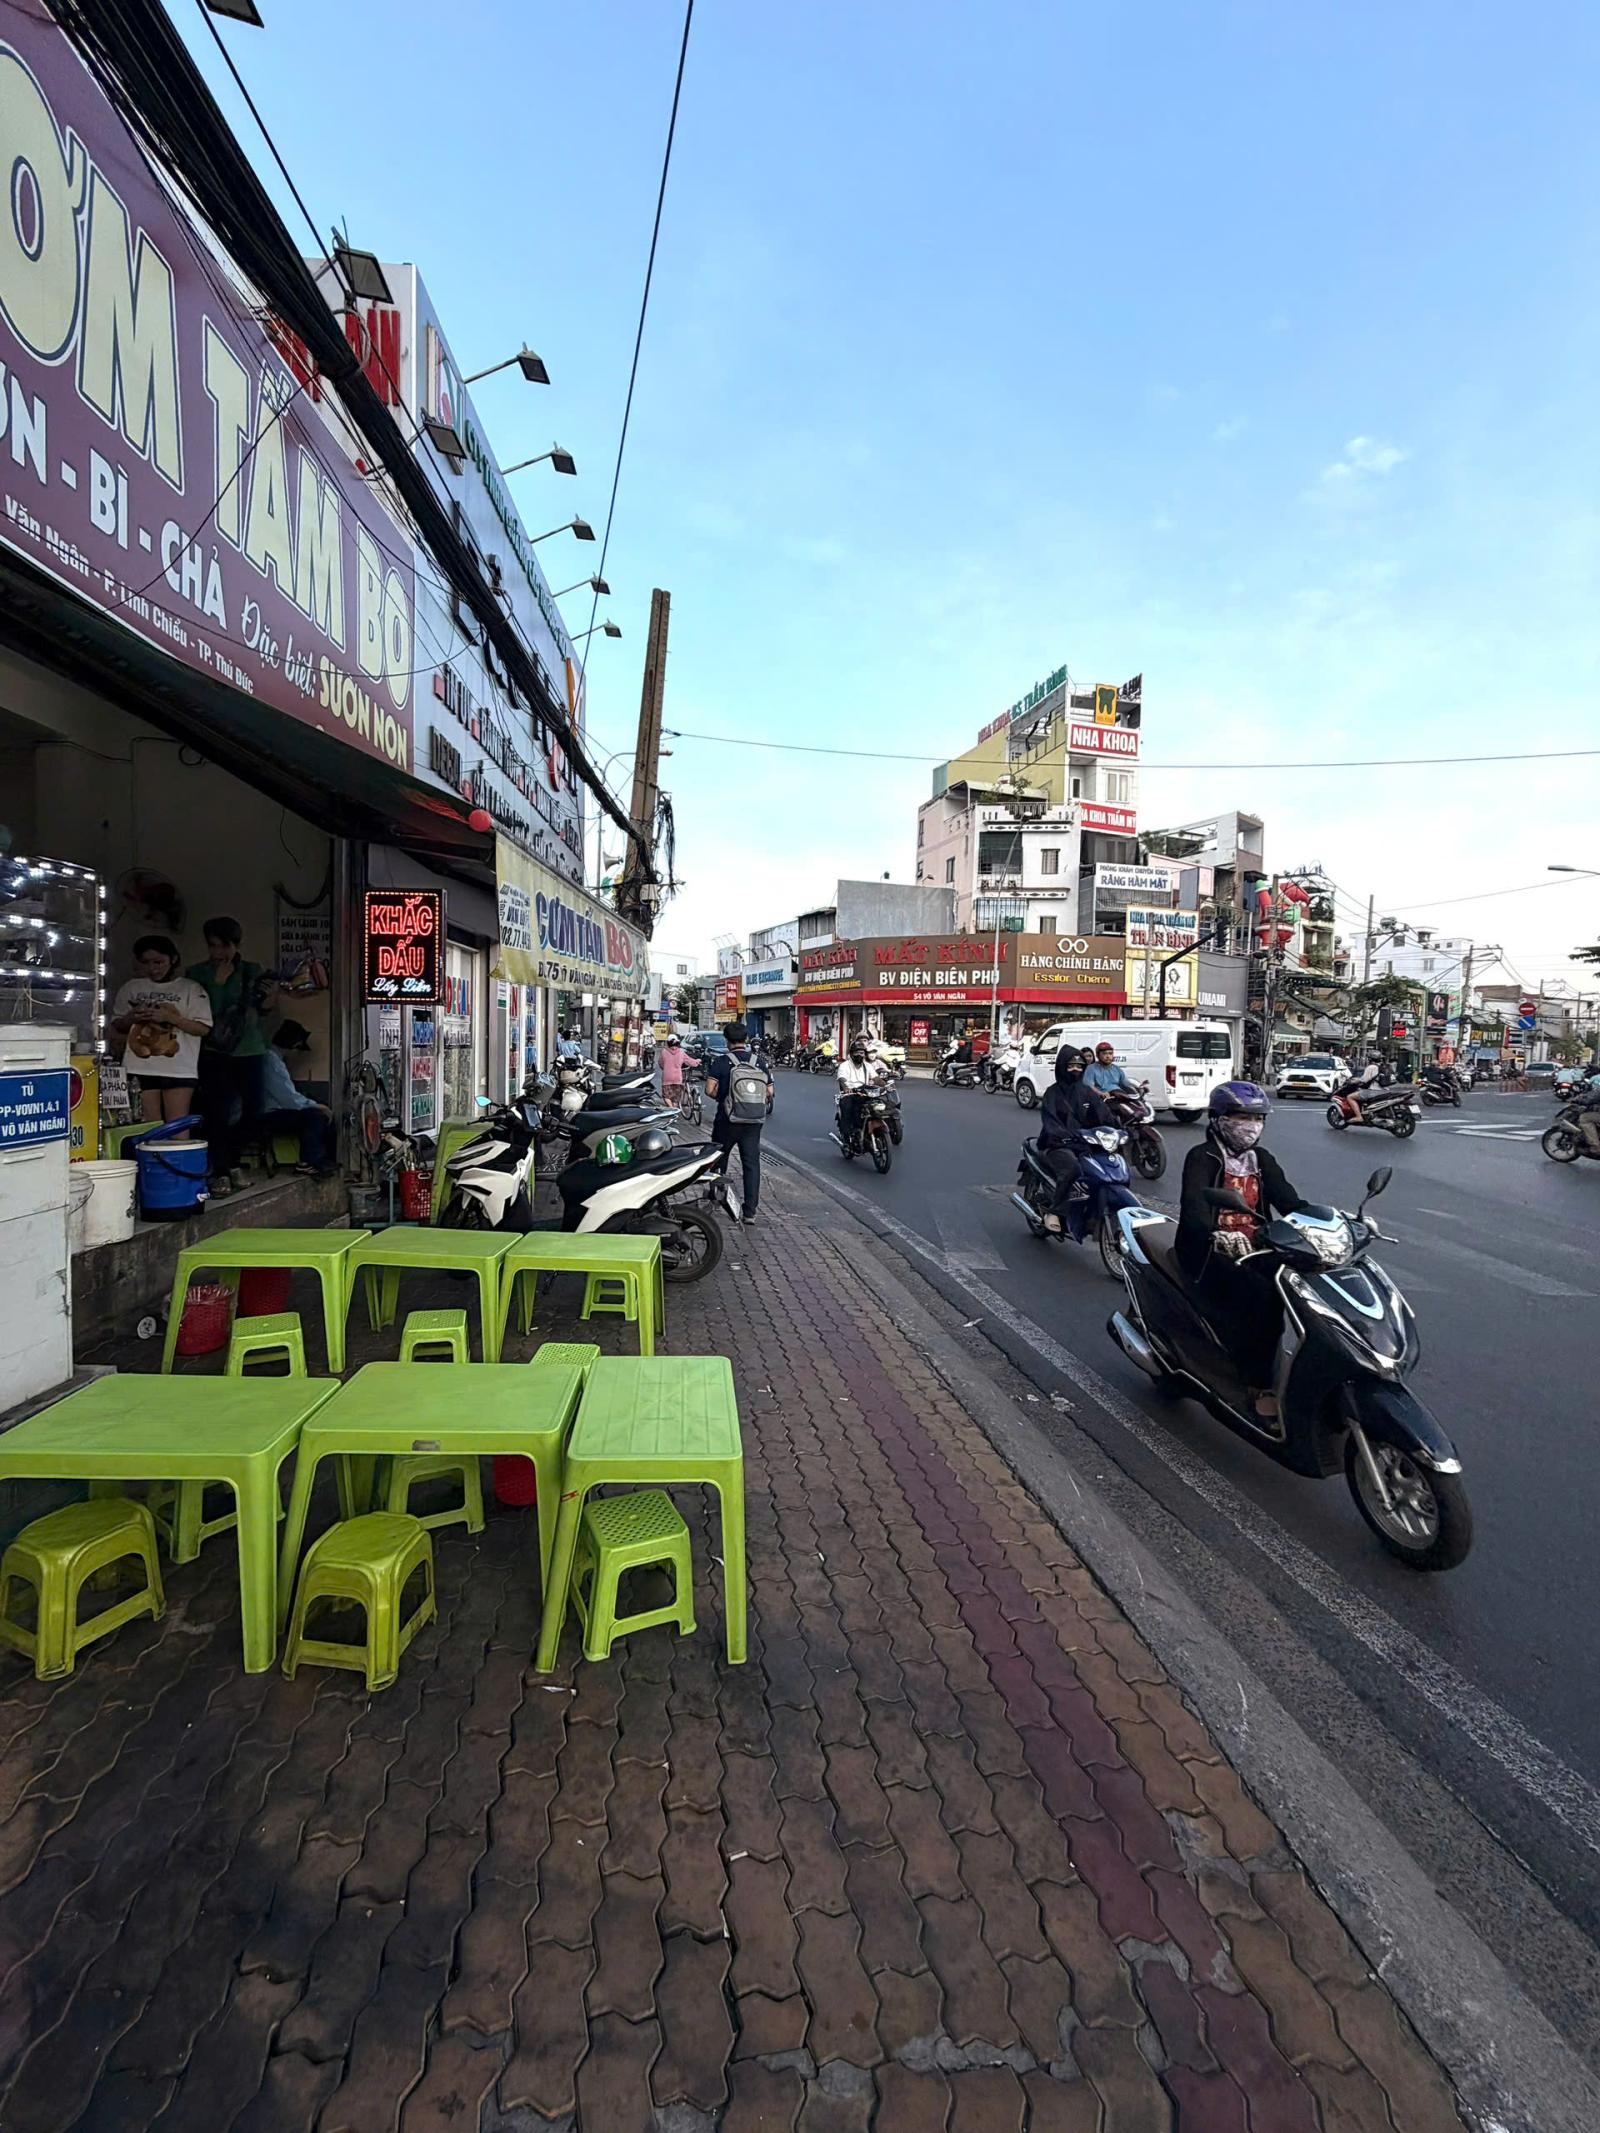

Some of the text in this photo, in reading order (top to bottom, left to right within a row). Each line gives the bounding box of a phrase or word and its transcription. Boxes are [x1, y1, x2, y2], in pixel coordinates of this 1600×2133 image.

[202, 314, 346, 654] TẤM
[357, 520, 417, 711] BO
[90, 449, 128, 551] BÌ
[161, 520, 227, 630] CHẢ
[5, 494, 41, 542] Văn
[45, 524, 90, 577] Ngân
[120, 580, 149, 620] Linh
[152, 605, 188, 648] Chiểu
[197, 638, 213, 666] TP.
[215, 651, 234, 680] Thủ
[235, 669, 254, 695] Đức
[241, 594, 280, 669] Đặc
[285, 634, 316, 698] biệt:
[374, 702, 408, 771] NON
[1072, 727, 1136, 753] NHA KHOA
[1101, 873, 1168, 890] RĂNG HÀM MẶT
[370, 896, 433, 936] KHẮC
[379, 936, 425, 977] DẤU
[936, 938, 1008, 964] KÍNH
[1021, 952, 1124, 971] HÀNG CHÍNH HÃNG
[880, 971, 896, 986] BV
[900, 967, 931, 988] ĐIỆN
[935, 966, 967, 986] BIÊN
[1034, 972, 1111, 984] Essilor Chemi
[947, 992, 966, 1000] NGÂN
[1198, 991, 1227, 1007] UMAMI
[21, 1081, 34, 1096] TỦ
[2, 1116, 66, 1137] VÕ VĂN NGÂN)
